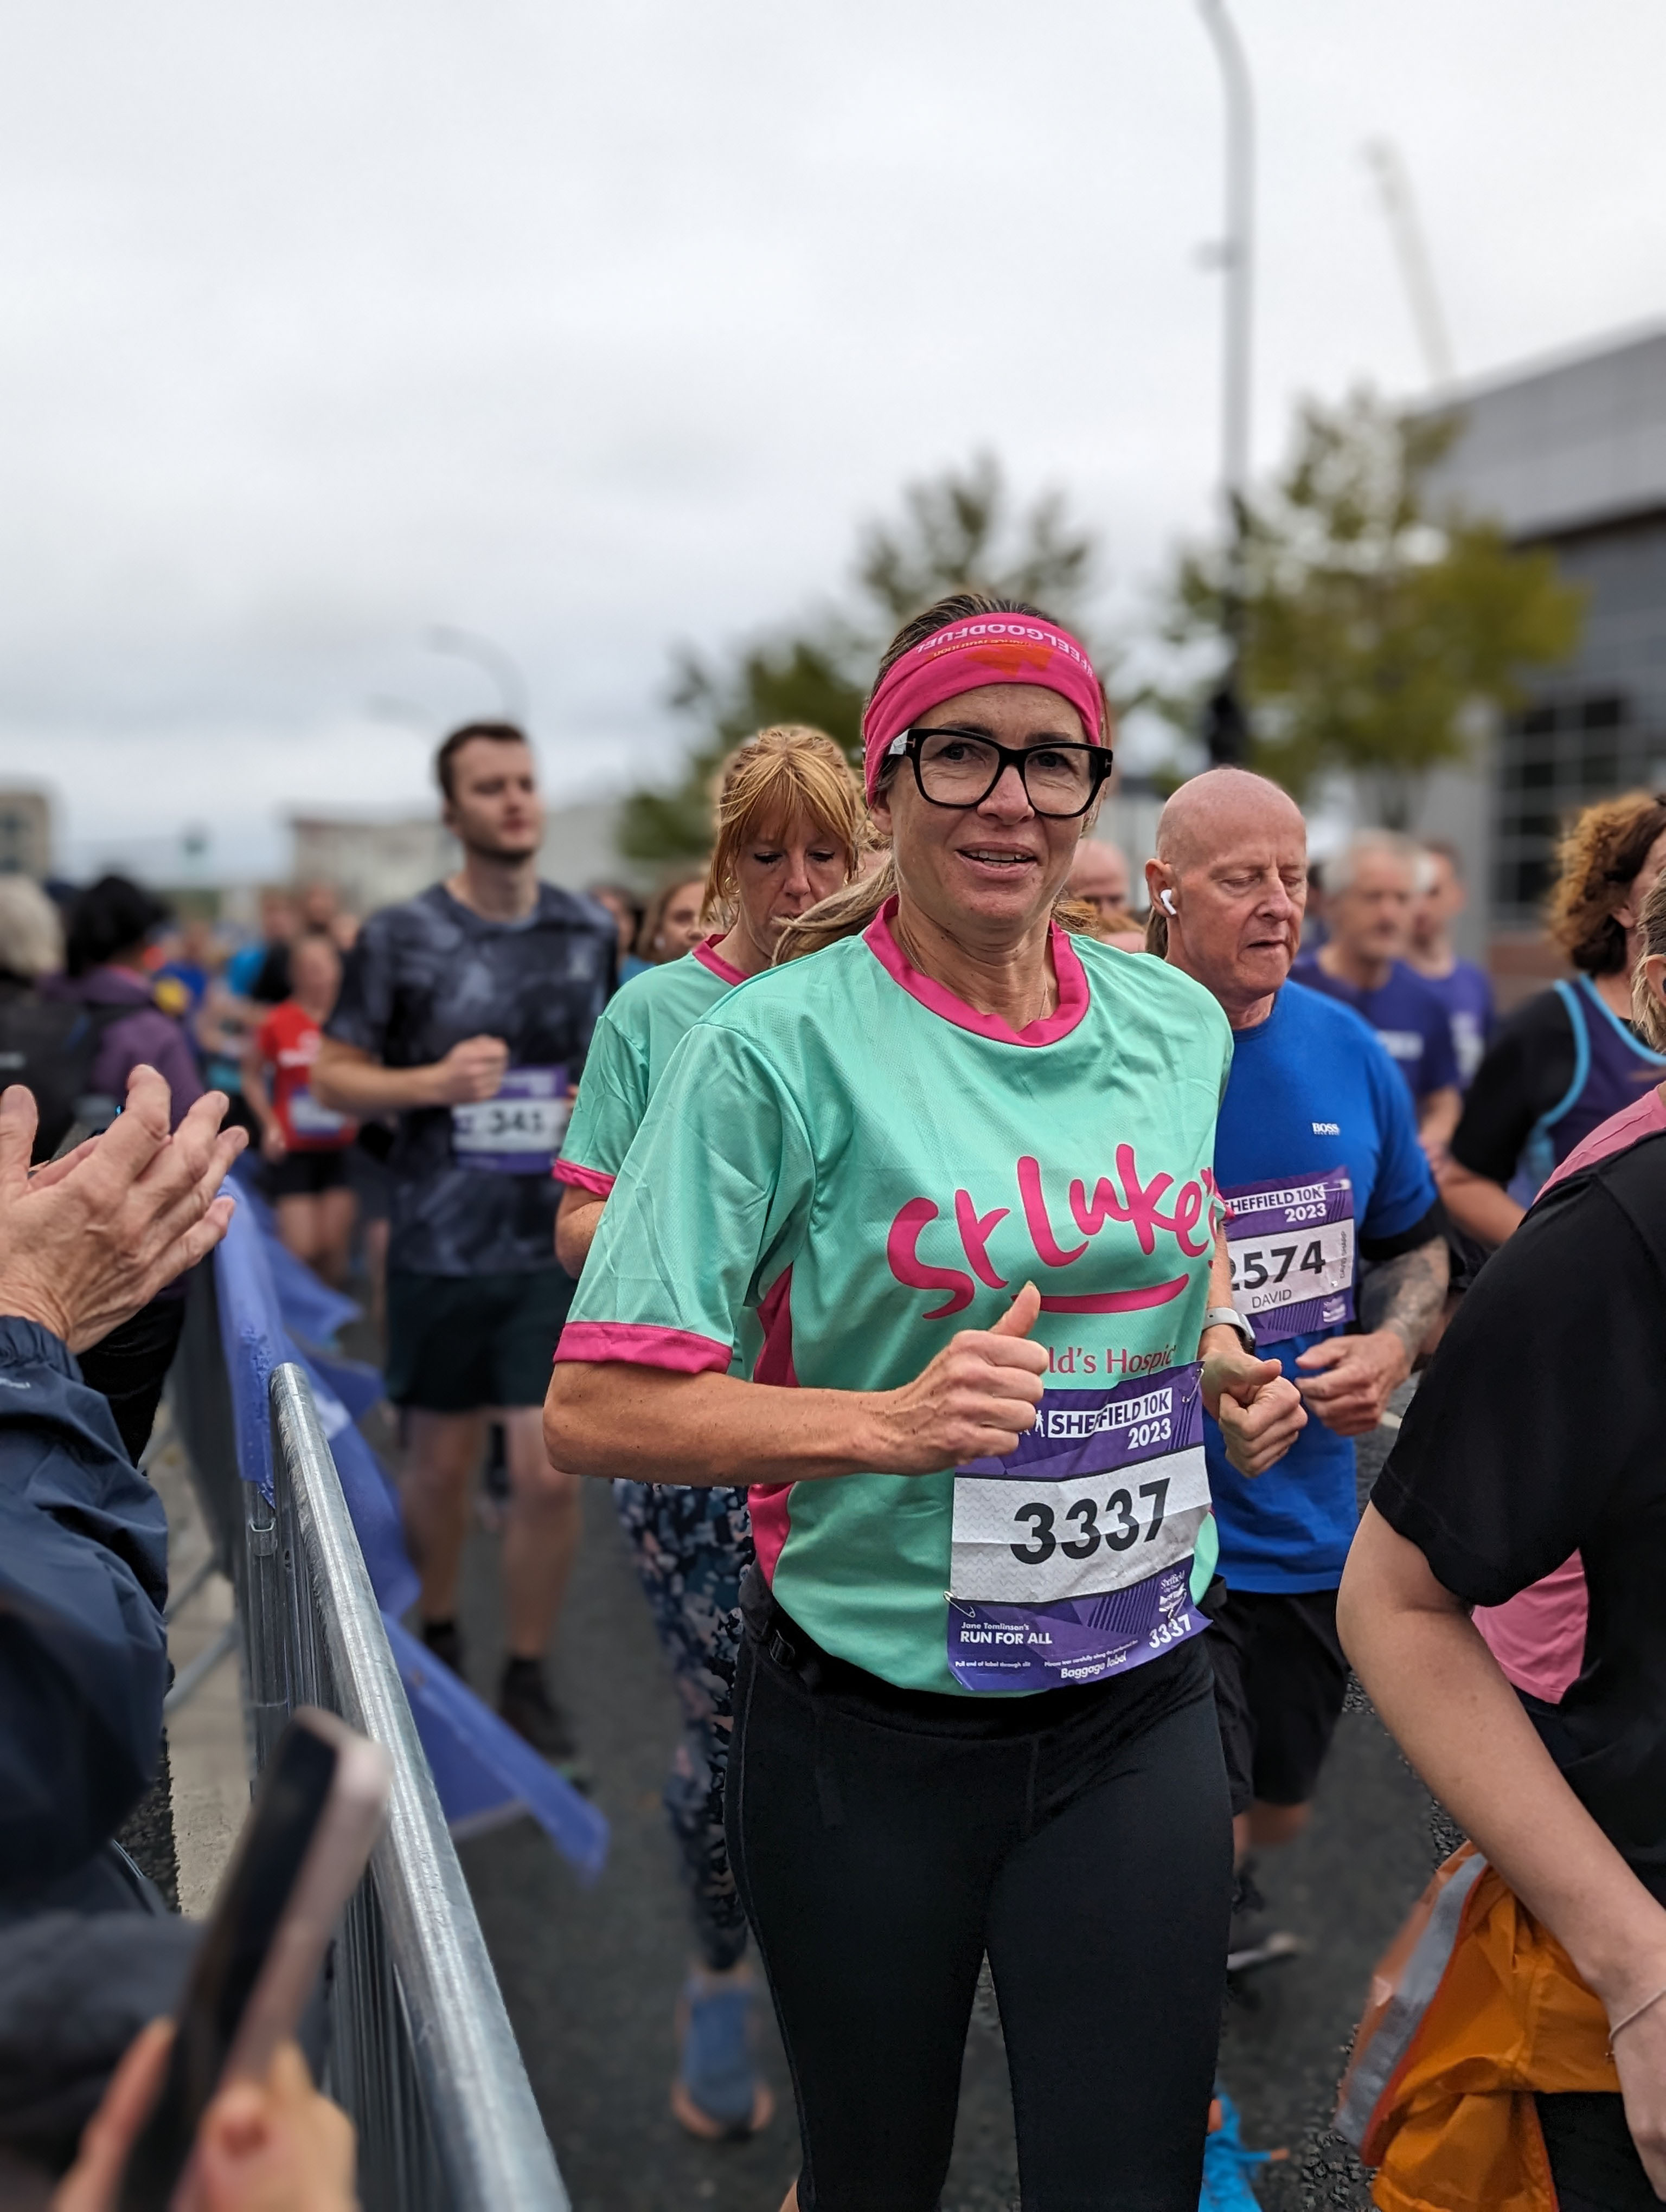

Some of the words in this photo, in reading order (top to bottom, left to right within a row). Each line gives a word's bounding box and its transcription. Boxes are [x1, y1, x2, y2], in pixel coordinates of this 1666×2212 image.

[1312, 1122, 1339, 1133] BOSS
[1225, 1192, 1295, 1212] HEFFIELD
[1284, 1203, 1327, 1223] 2023
[1252, 1289, 1292, 1309] DAVID
[1107, 1345, 1177, 1375] Hospic
[1050, 1401, 1141, 1435] SHEFFIELD
[1143, 1391, 1170, 1416] 10K
[1127, 1418, 1171, 1450] 2023
[1010, 1477, 1171, 1565] 3337
[960, 1631, 992, 1644] RUN
[995, 1631, 1024, 1645] FOR
[1027, 1632, 1053, 1644] ALL
[983, 1623, 1029, 1631] Tomlinson's
[1149, 1613, 1192, 1649] 3337
[1061, 1662, 1105, 1679] Baggage
[1107, 1650, 1127, 1668] label
